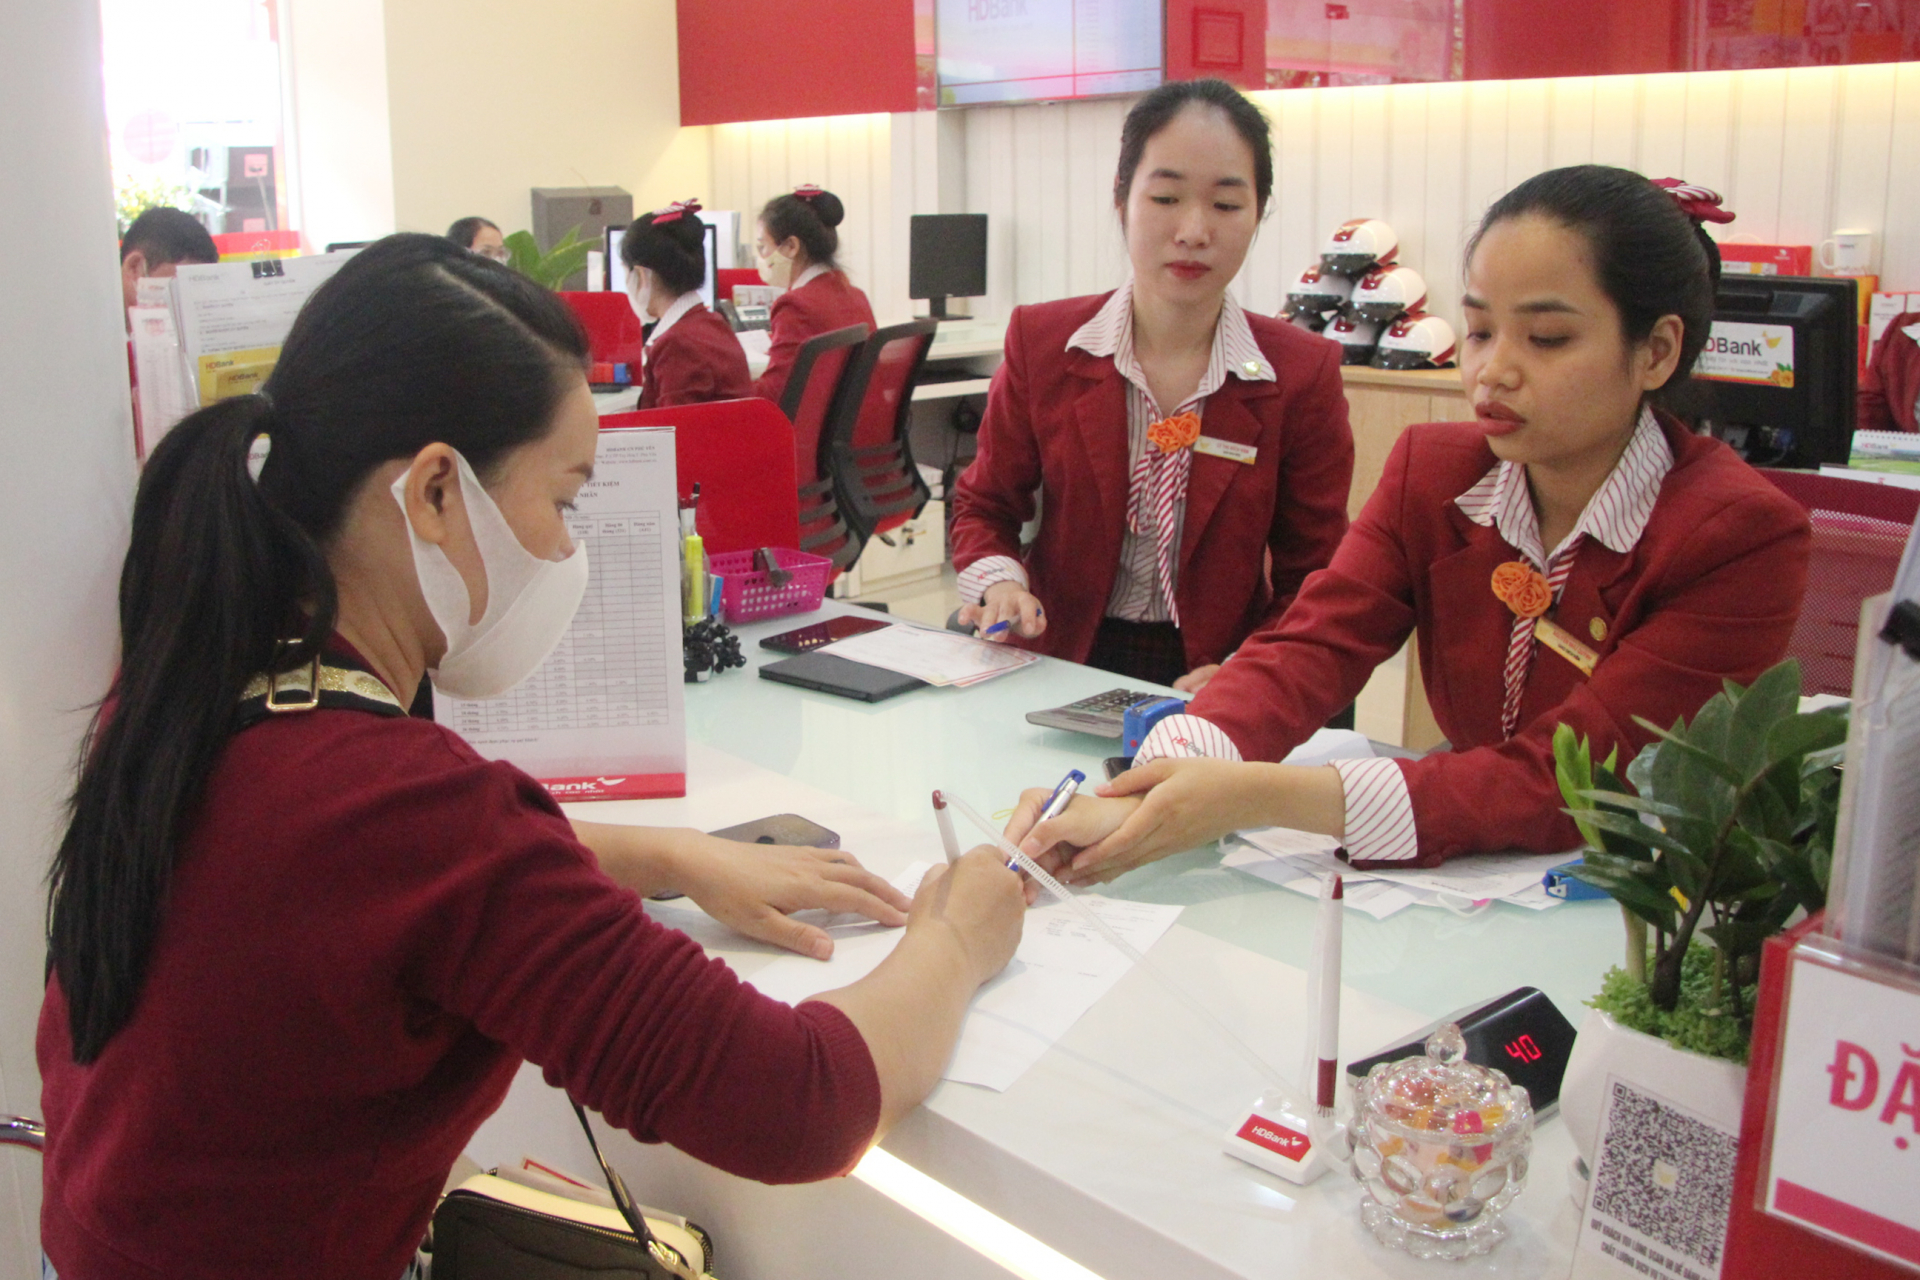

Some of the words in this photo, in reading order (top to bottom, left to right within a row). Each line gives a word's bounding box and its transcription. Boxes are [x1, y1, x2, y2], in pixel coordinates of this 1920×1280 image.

[967, 0, 1028, 22] HDBank
[205, 360, 235, 370] HDBank
[1504, 1034, 1542, 1063] 40
[1251, 1125, 1290, 1147] HDBank
